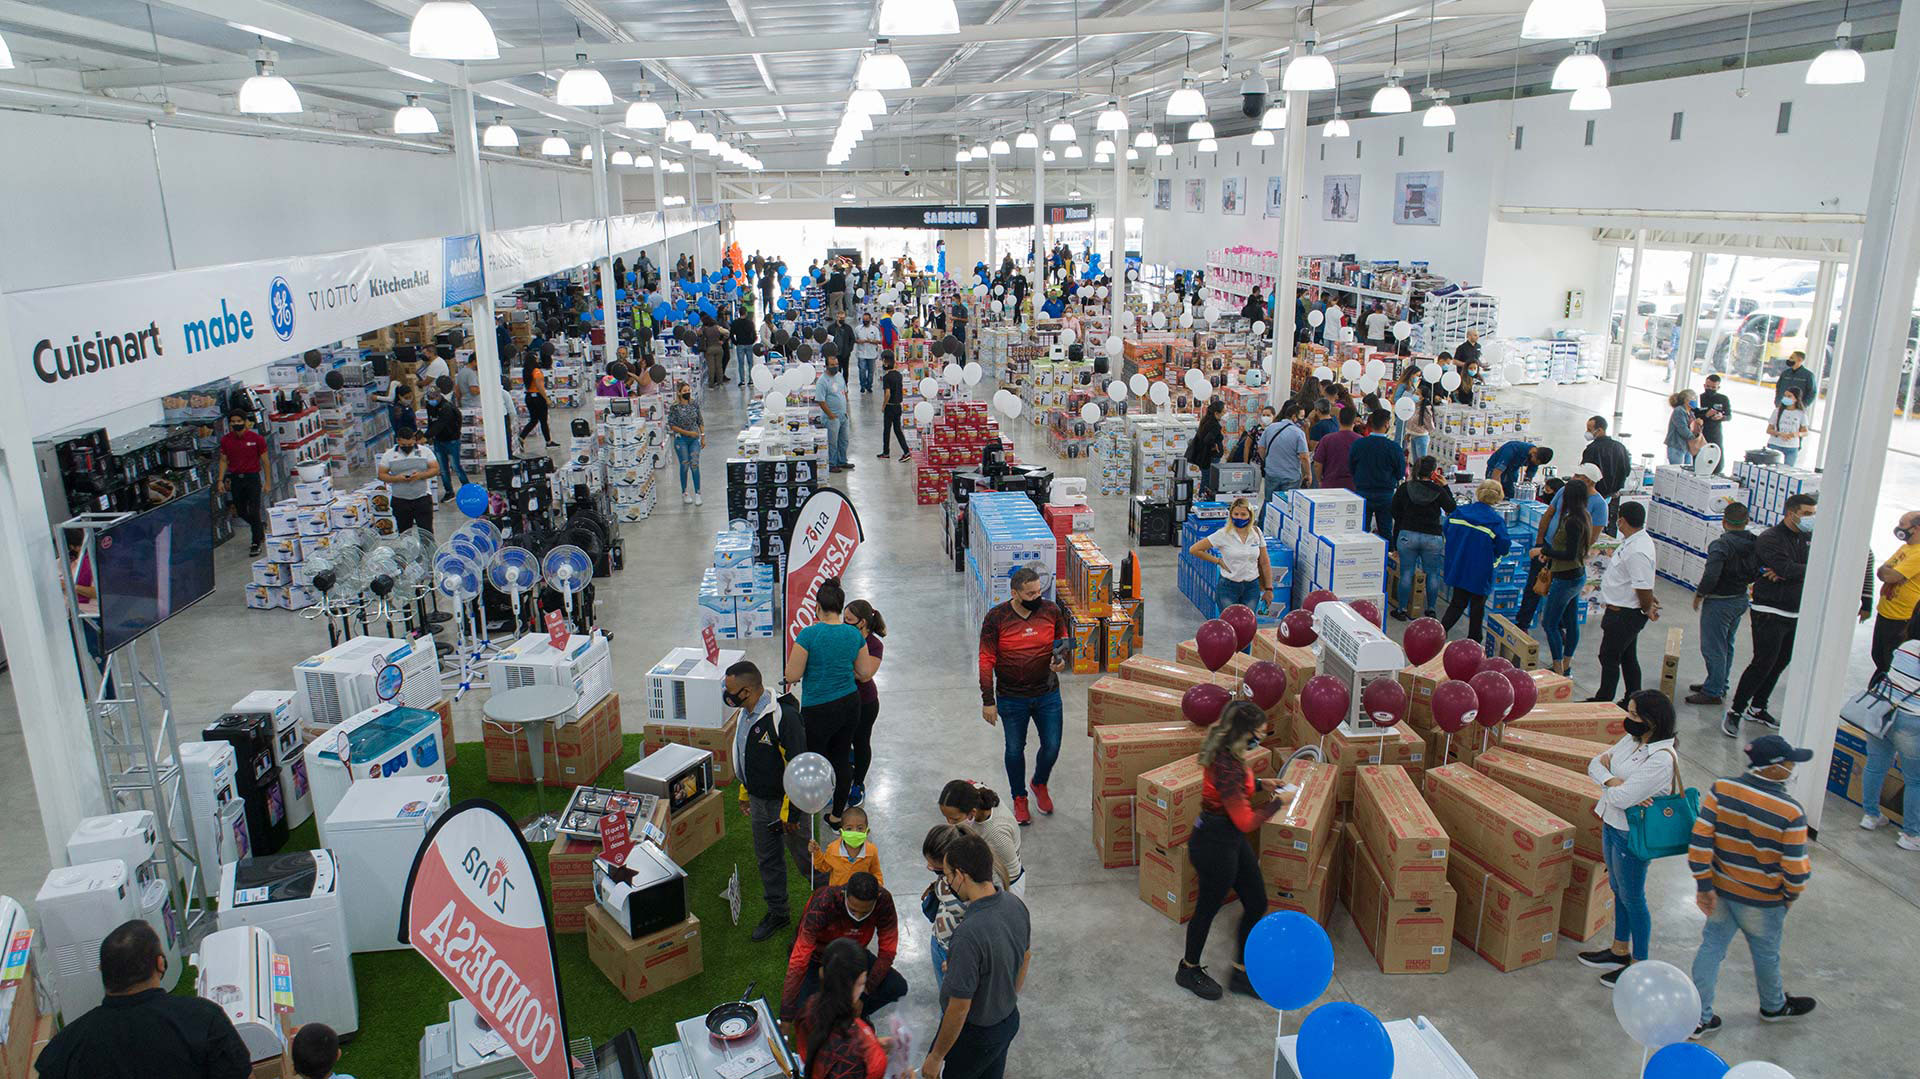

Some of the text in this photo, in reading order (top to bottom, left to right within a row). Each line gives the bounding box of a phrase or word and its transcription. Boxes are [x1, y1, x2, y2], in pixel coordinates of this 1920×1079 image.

[923, 211, 978, 225] SAMSUNG
[33, 320, 163, 383] Cuisinart
[183, 298, 254, 354] mabe
[308, 283, 359, 311] VIOTTO
[369, 270, 430, 298] KitchenAid
